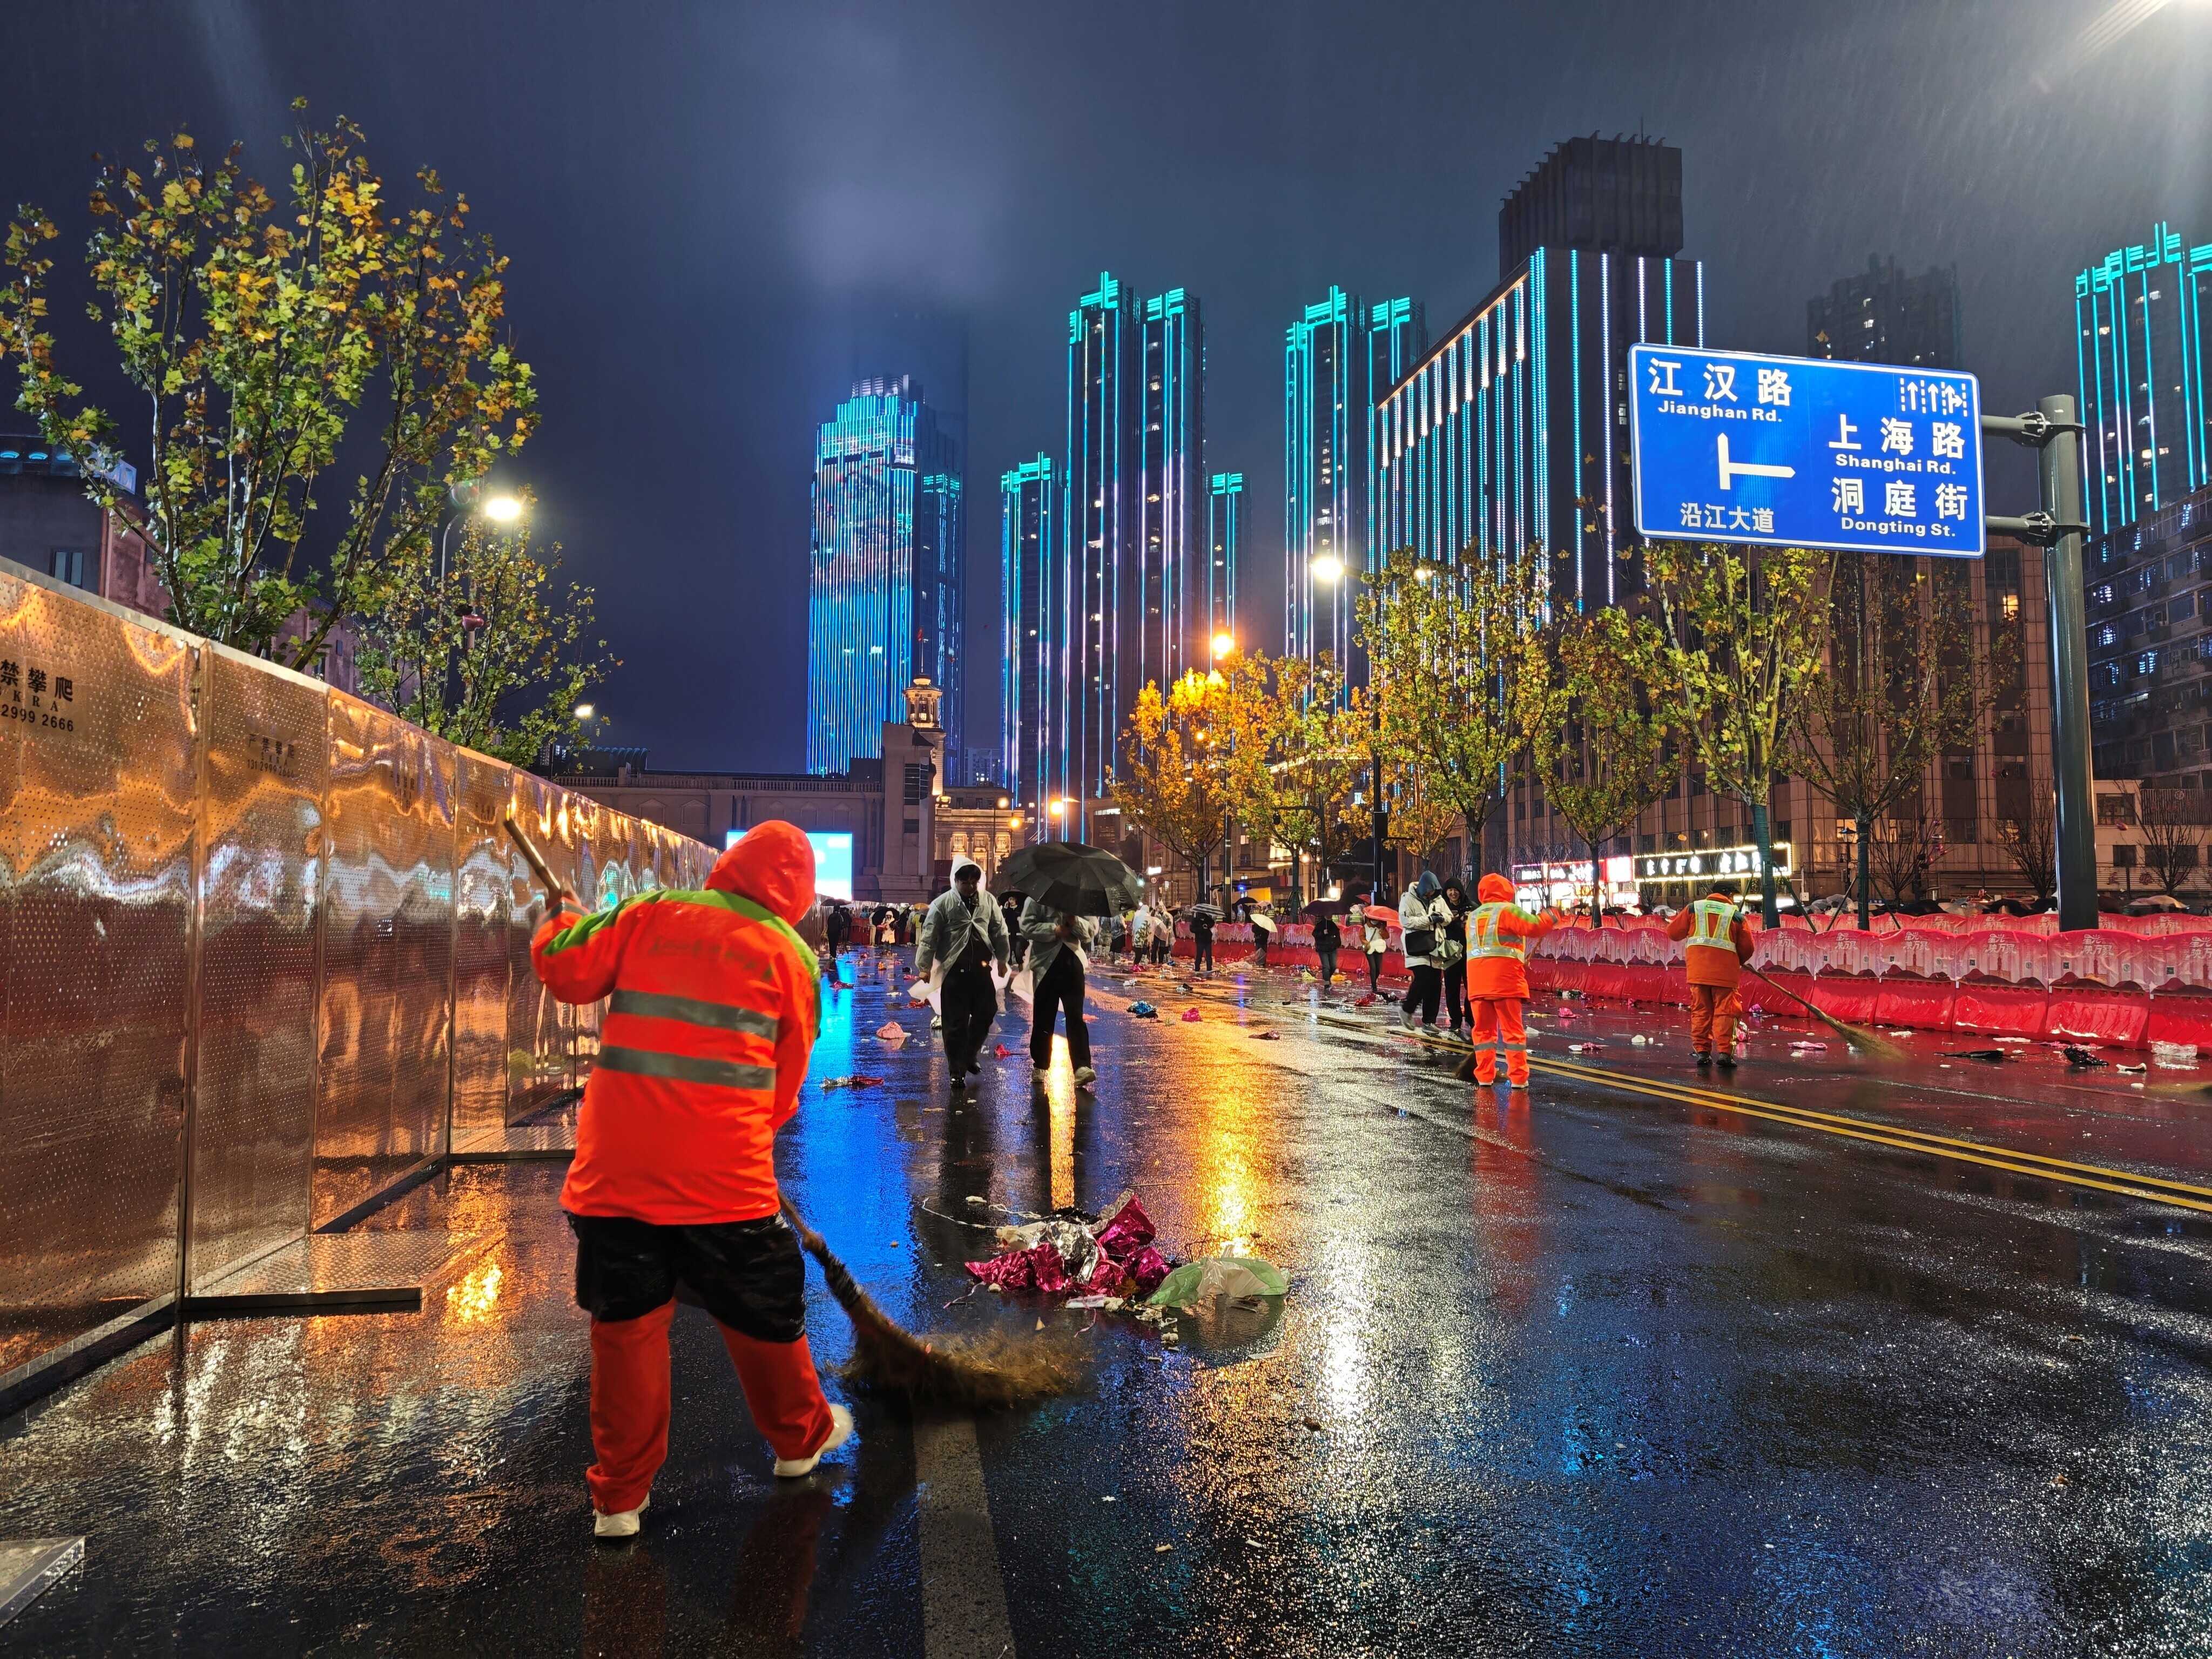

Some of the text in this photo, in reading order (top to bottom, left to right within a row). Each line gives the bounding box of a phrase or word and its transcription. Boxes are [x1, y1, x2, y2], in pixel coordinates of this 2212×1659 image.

[1648, 357, 1792, 407] 江汉路
[1658, 400, 1782, 422] Jianghan Rd.
[1828, 414, 1965, 459] 上海路
[1836, 453, 1956, 475] Shanghai Rd.
[1831, 476, 1968, 521] 洞庭街
[1680, 502, 1775, 533] 沿江大道
[1841, 517, 1956, 537] Dongting St.
[42, 713, 74, 732] 2666
